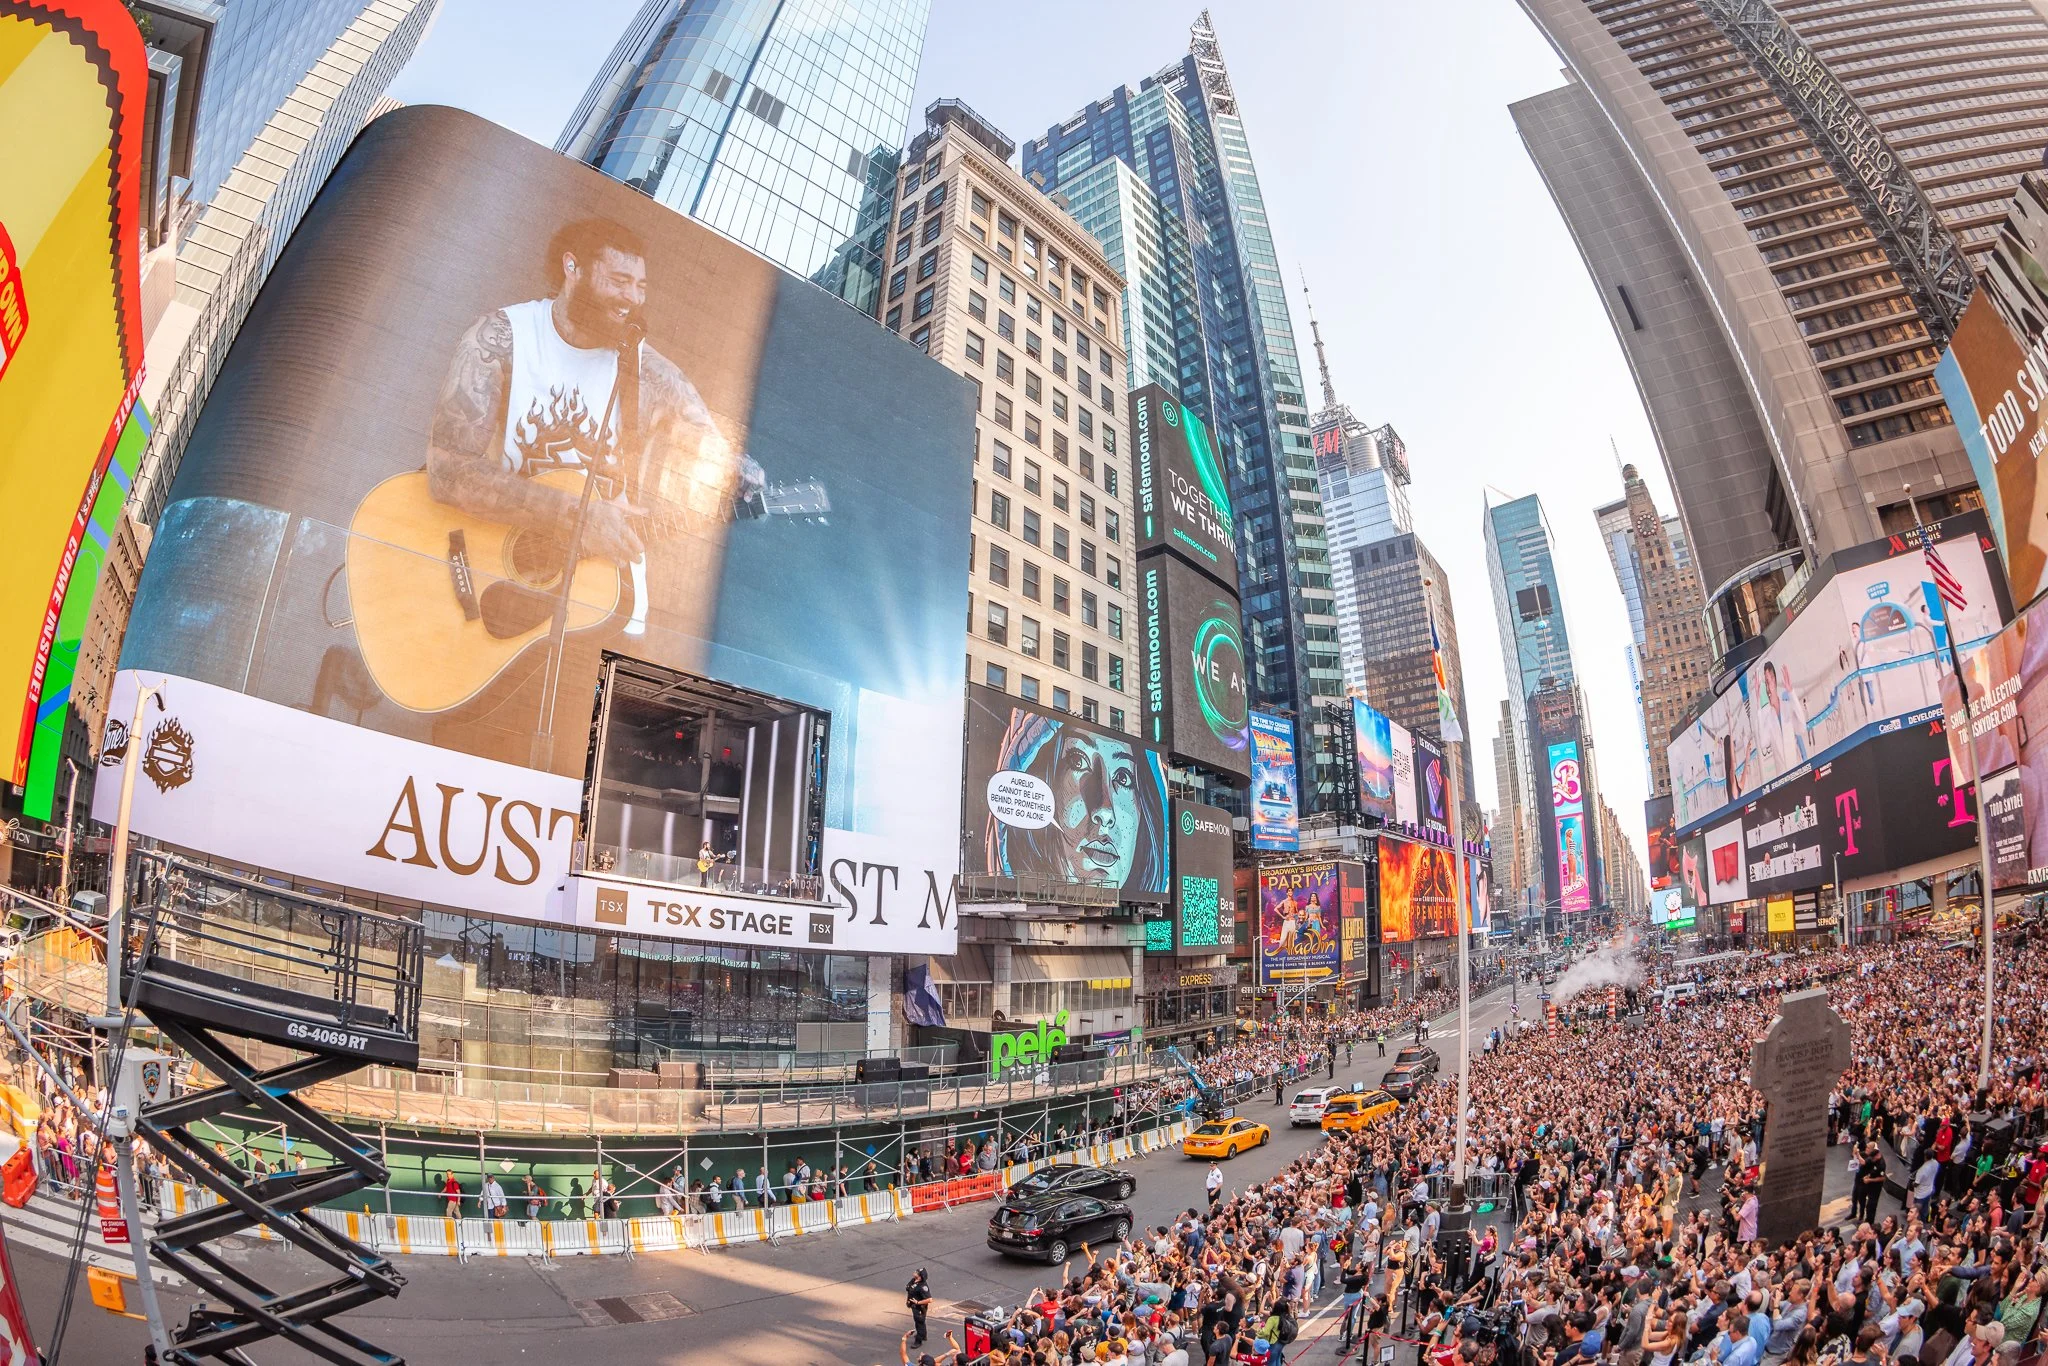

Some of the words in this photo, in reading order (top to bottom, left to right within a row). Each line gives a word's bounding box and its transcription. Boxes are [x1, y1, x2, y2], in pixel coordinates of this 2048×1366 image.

[1764, 39, 1813, 101] EAGLE
[1793, 46, 1892, 172] OUTFITTERS
[1812, 97, 1902, 216] AMERICAN
[1980, 389, 2025, 464] TODD
[1137, 396, 1153, 513] safemoon.com
[1170, 491, 1196, 524] WE
[1173, 527, 1218, 563] safemoon.com
[52, 535, 79, 608] COME
[1147, 569, 1162, 712] safemoon.com
[28, 608, 58, 704] INSIDE!
[1191, 650, 1220, 682] WE
[1628, 646, 1639, 684] Protected
[1981, 674, 2023, 712] COLLECTION
[1251, 728, 1292, 751] BACK
[998, 785, 1022, 797] CANNOT
[1023, 790, 1031, 798] BE
[1032, 792, 1045, 801] LEFT
[1011, 778, 1034, 789] AURELIO
[997, 805, 1014, 815] MUST
[1015, 809, 1025, 817] GO
[1026, 811, 1045, 822] ALONE.
[1014, 798, 1052, 812] PROMETHEUS
[1989, 801, 2003, 817] TODD
[1194, 819, 1231, 837] SAFEMOON
[1402, 820, 1434, 843] 1540
[1773, 842, 1789, 853] SEPHORA
[1261, 867, 1305, 877] BROADWAY'S
[1305, 863, 1335, 873] BIGGEST
[1268, 871, 1329, 890] PARTY!
[600, 899, 624, 913] TSX
[647, 900, 702, 928] TSX
[709, 902, 793, 936] STAGE
[812, 923, 831, 934] TSX
[1817, 917, 1838, 927] SEPHORA
[1264, 928, 1336, 957] Aladdin
[1180, 973, 1212, 987] EXPRESS
[287, 1023, 347, 1046] GS-4069
[348, 1035, 368, 1050] RT
[1776, 1051, 1803, 1063] FRANCIS
[1811, 1044, 1834, 1055] DUFFY
